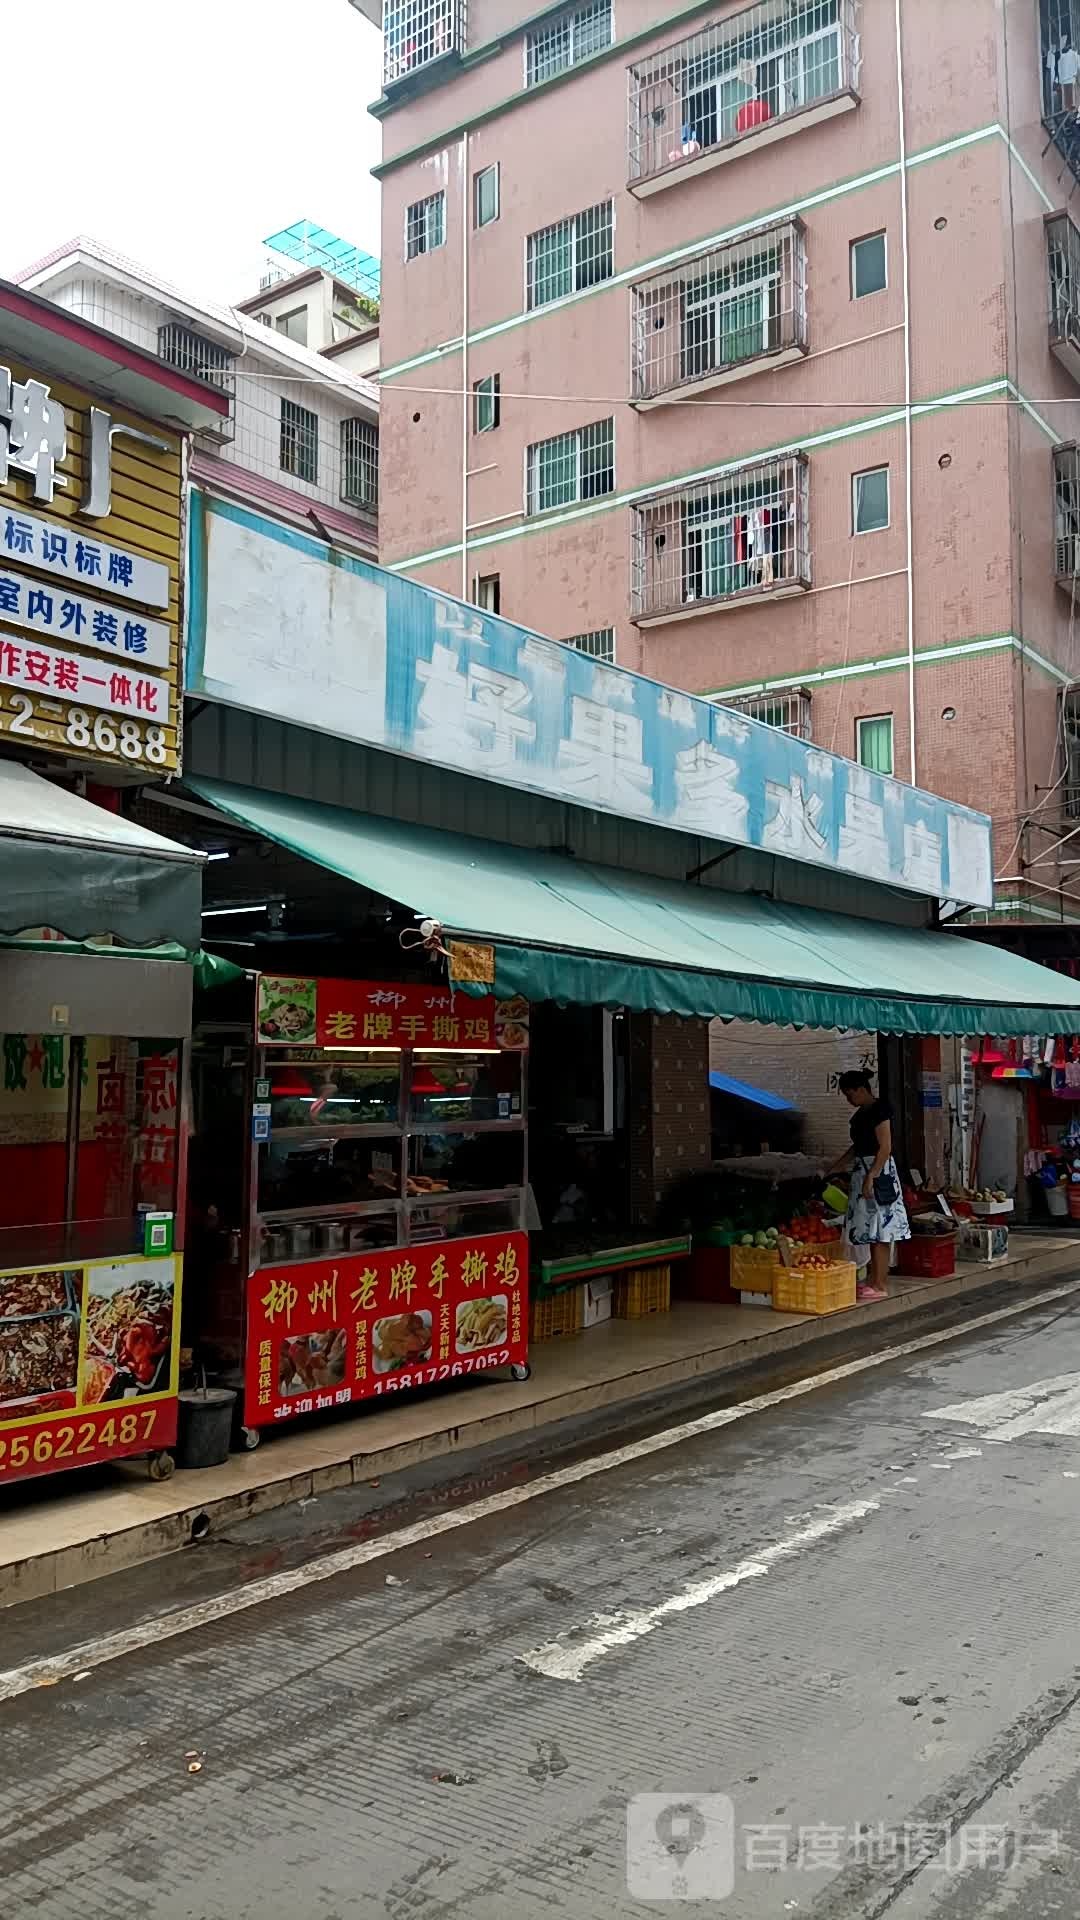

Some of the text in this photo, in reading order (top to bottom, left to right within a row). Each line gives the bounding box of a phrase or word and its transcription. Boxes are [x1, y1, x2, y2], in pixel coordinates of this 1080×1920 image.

[5, 515, 134, 588] 标识标牌
[0, 577, 148, 655] 室内外装修
[0, 693, 167, 764] 2-8688
[325, 1011, 490, 1042] 老牌手撕鸡
[367, 989, 456, 1012] 柳州
[260, 1243, 521, 1328] 柳州老牌手撕鸡
[354, 1319, 368, 1381] 现杀活鸡
[439, 1303, 450, 1360] 天天新鲜
[257, 1339, 273, 1406] 质量保证
[0, 1409, 157, 1471] 5622487
